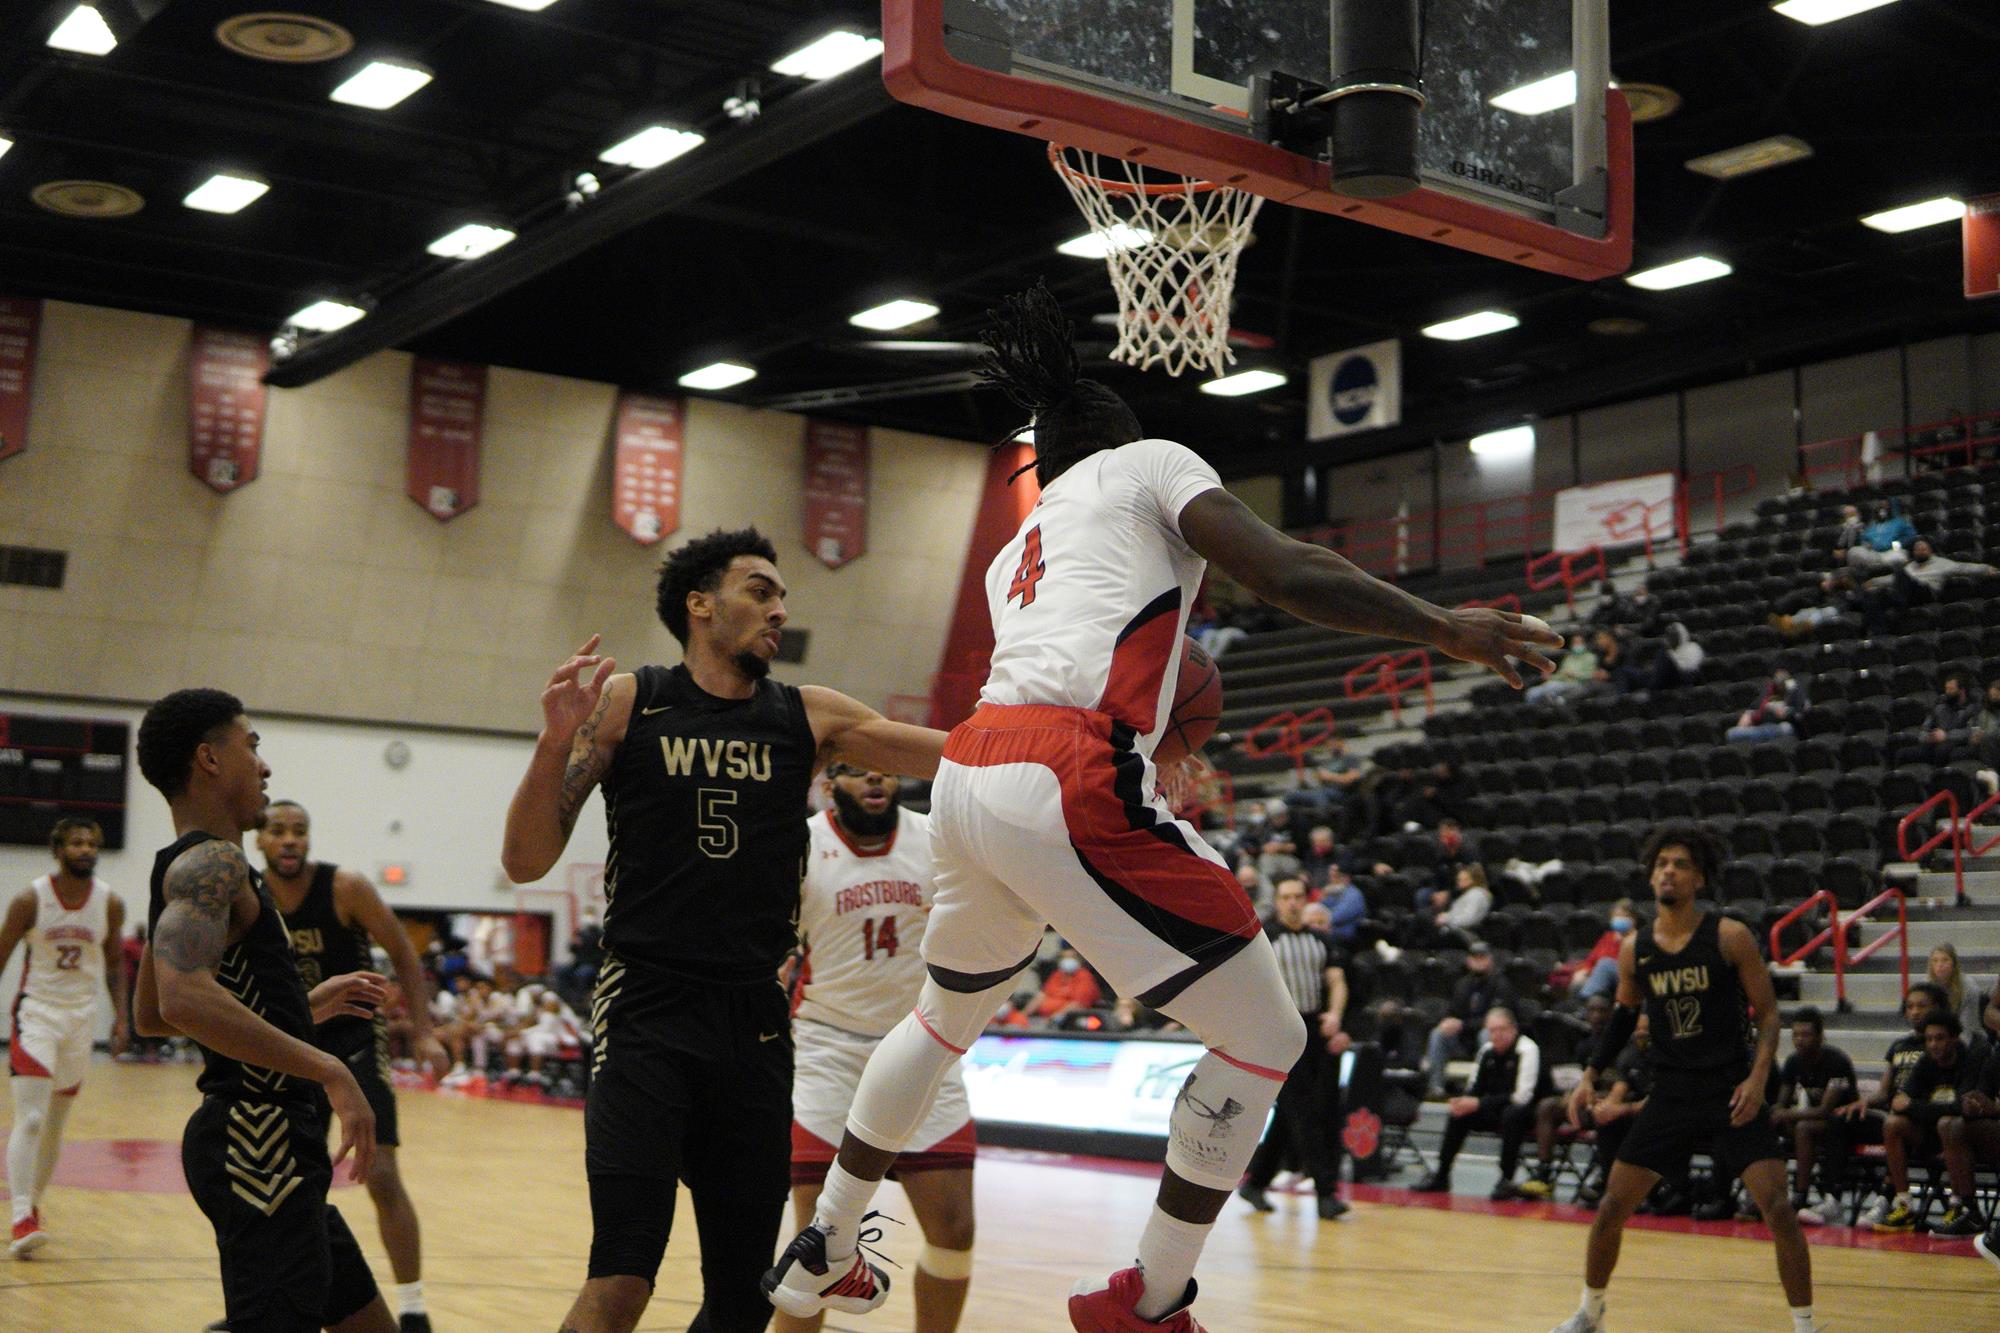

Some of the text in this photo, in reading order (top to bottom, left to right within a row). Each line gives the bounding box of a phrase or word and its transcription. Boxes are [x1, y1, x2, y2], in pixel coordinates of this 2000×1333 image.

[1007, 523, 1046, 610] 4
[660, 735, 772, 782] WVSU
[698, 787, 738, 859] 5
[835, 880, 922, 916] FROSTBURG
[56, 944, 82, 970] 22
[862, 915, 899, 960] 14
[1648, 965, 1710, 996] WVSU
[1665, 995, 1703, 1038] 12
